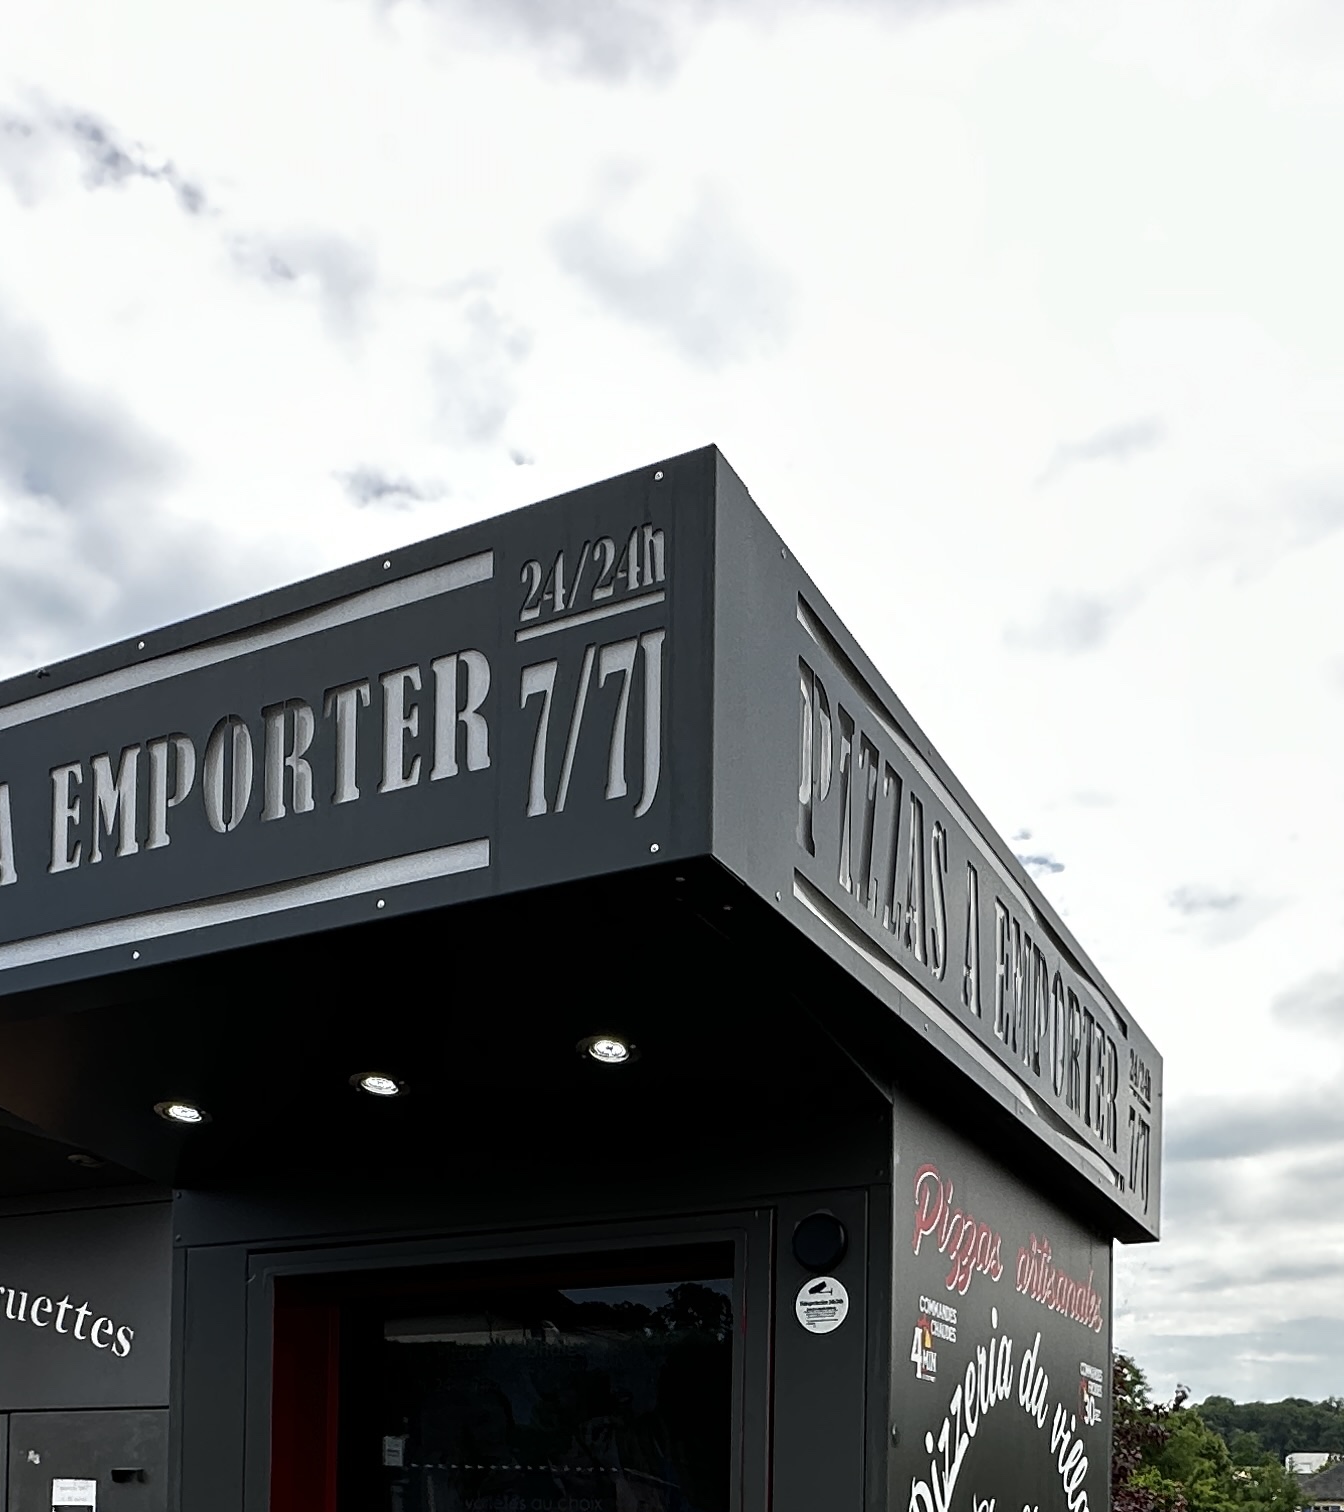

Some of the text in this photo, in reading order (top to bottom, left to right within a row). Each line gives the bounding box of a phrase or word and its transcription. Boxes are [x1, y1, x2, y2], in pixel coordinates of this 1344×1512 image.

[518, 523, 665, 623] 24/24h
[49, 648, 492, 874] EMPORTER
[518, 628, 665, 818] 7/7J
[798, 655, 1119, 1153] PIZZAS A EMPORTER
[911, 1163, 1104, 1334] Pizzas artisanales
[911, 1326, 923, 1378] 4
[1018, 1332, 1050, 1430] du
